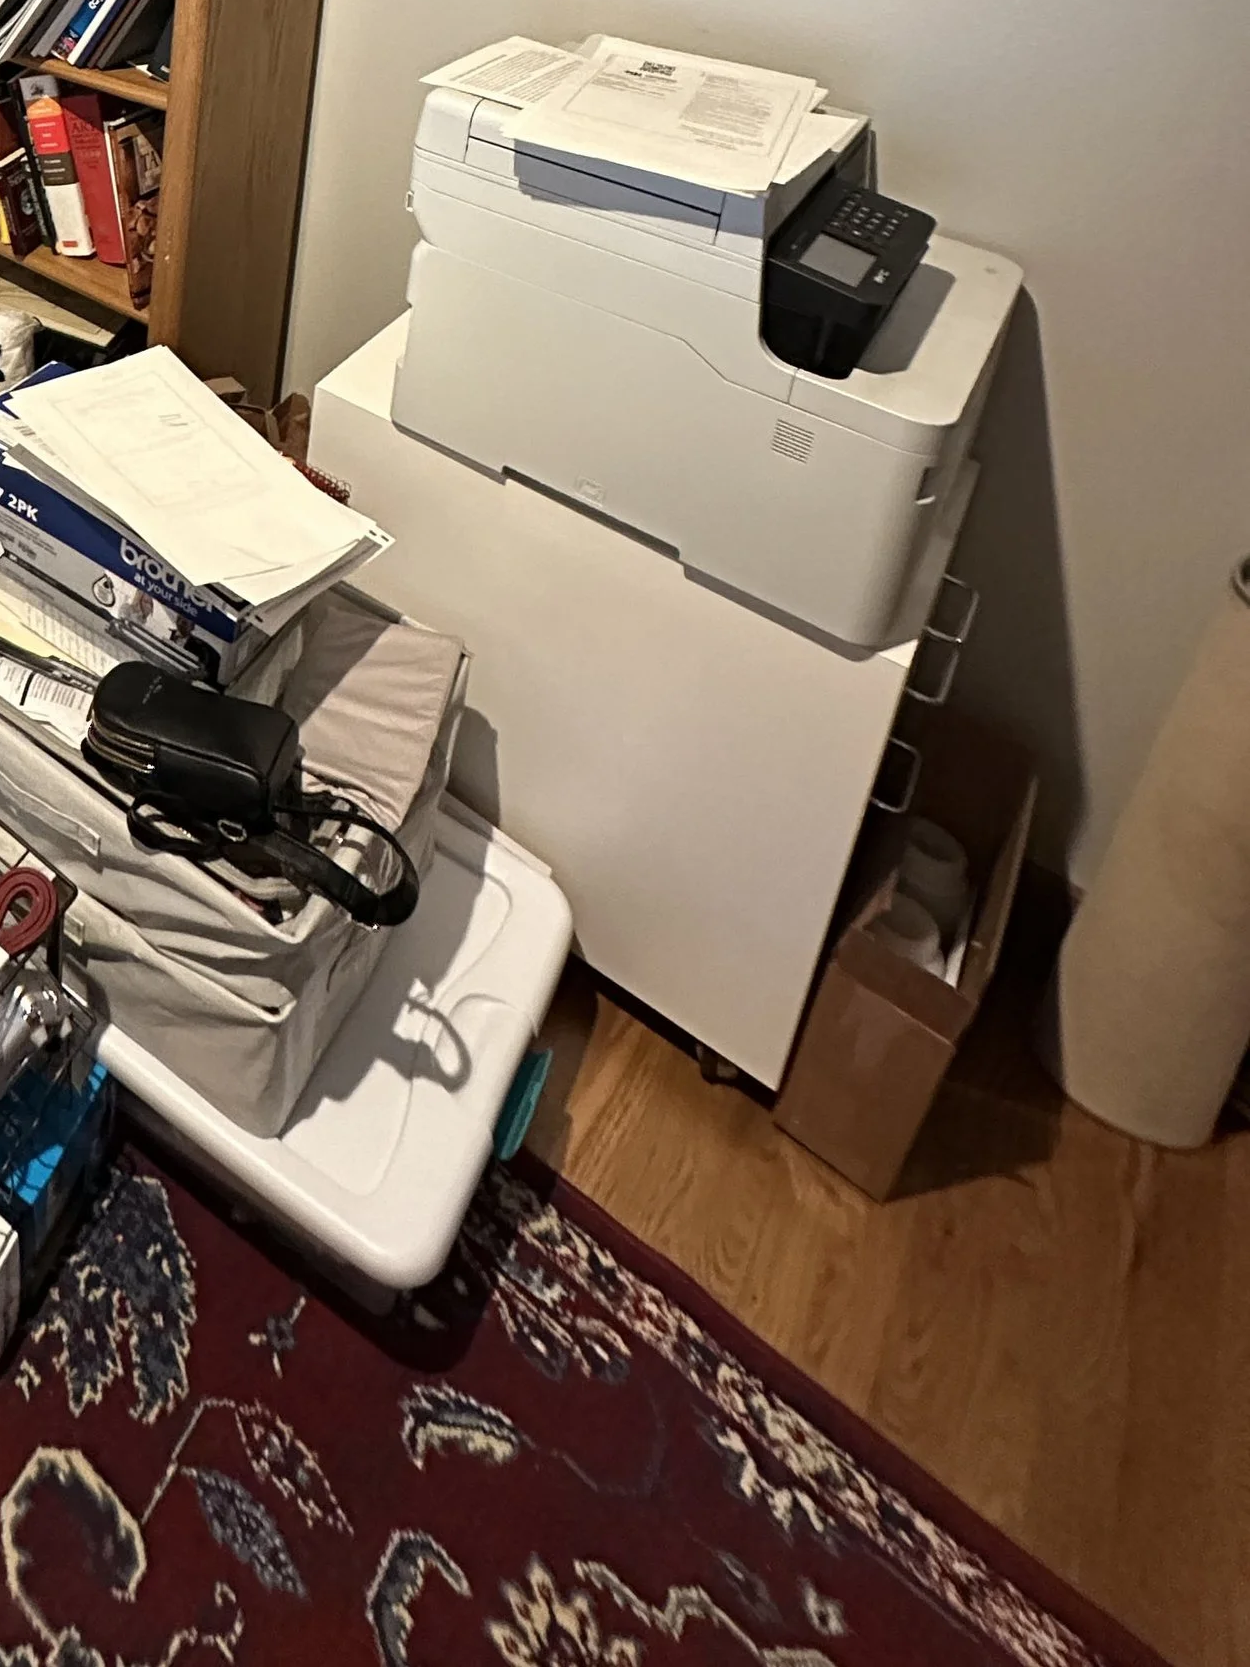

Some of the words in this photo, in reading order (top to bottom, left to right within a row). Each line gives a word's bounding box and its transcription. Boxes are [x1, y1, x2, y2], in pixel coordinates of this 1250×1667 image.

[7, 492, 39, 523] 2PK
[133, 572, 146, 585] at
[146, 577, 174, 604] your
[173, 589, 199, 618] side
